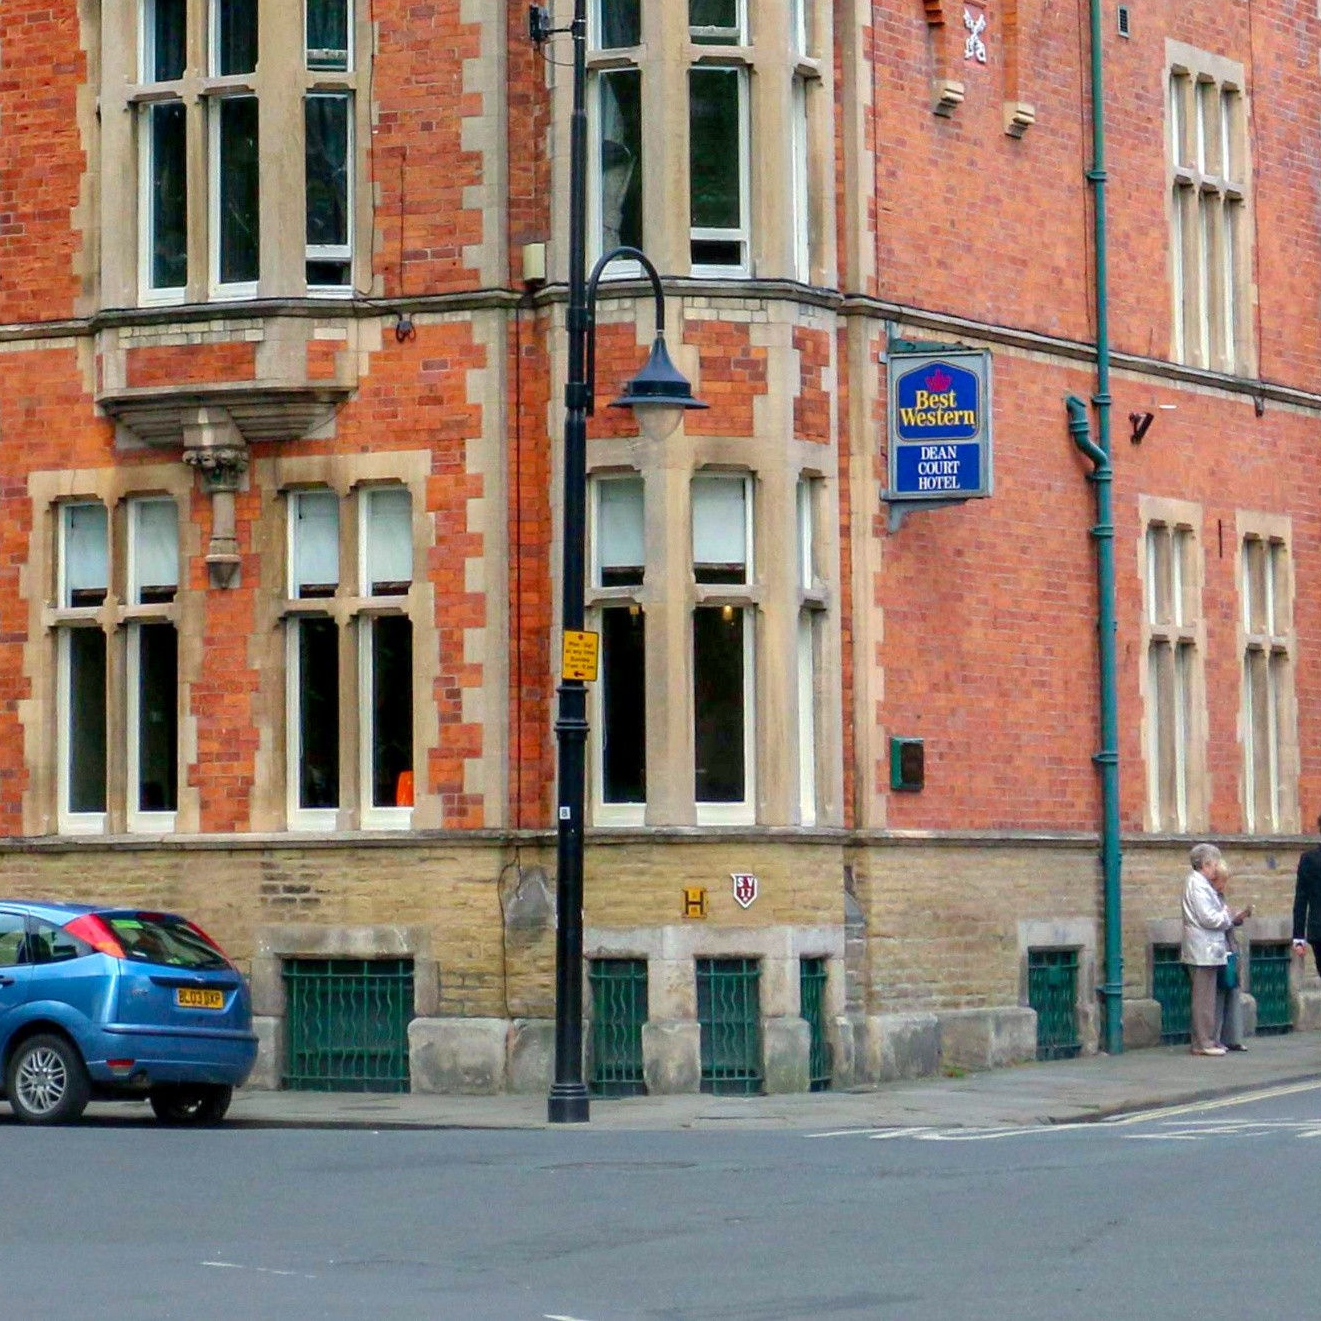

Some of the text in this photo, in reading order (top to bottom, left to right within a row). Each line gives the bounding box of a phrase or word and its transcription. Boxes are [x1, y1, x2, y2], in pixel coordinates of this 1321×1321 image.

[916, 389, 957, 409] Best
[900, 407, 976, 426] Western
[921, 446, 957, 460] DEAN
[918, 461, 960, 475] COURT
[918, 476, 960, 490] HOTEL
[740, 888, 753, 897] 17
